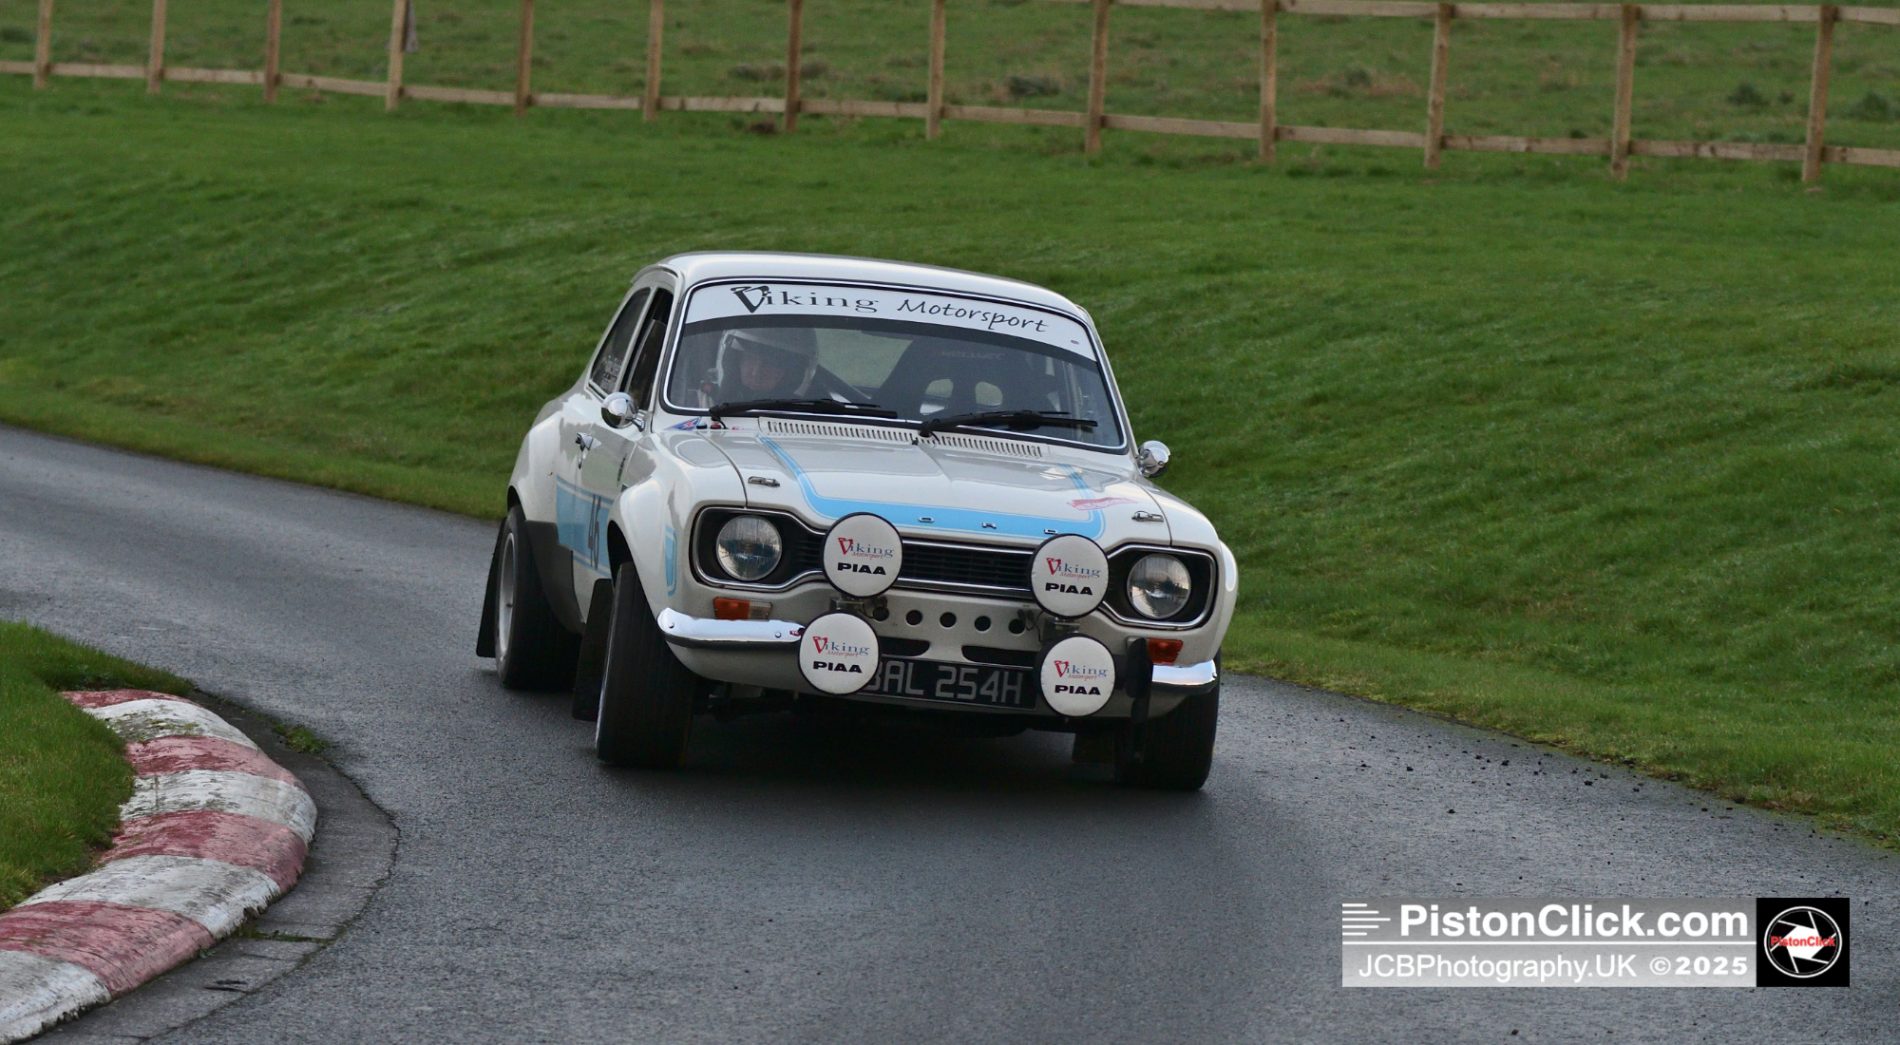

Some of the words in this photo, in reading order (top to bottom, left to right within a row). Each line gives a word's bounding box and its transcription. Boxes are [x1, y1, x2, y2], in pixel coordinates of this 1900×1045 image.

[730, 285, 879, 313] Viking
[897, 299, 1050, 333] Motorsport
[838, 537, 894, 558] Viking
[837, 562, 887, 576] PIAA
[1046, 557, 1101, 579] Viking
[1045, 582, 1093, 596] PIAA
[812, 636, 870, 655] Viking
[813, 660, 862, 674] PIAA
[1053, 660, 1108, 678] Viking
[935, 665, 1024, 705] 254H
[1055, 684, 1101, 696] PIAA
